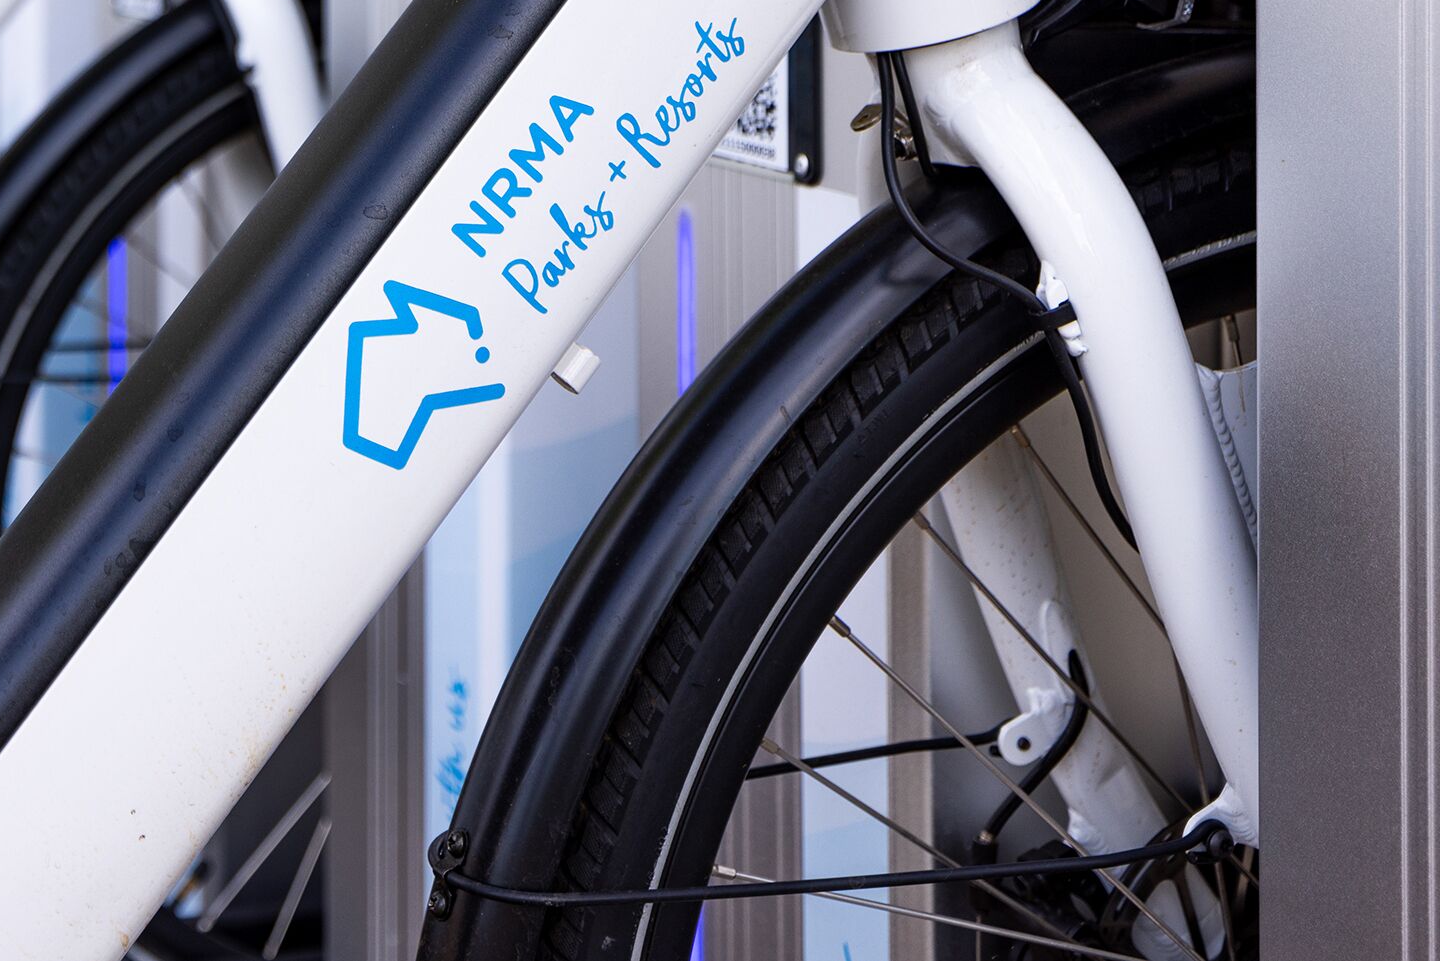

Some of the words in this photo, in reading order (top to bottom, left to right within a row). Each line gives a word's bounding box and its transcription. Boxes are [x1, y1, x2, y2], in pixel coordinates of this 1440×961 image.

[616, 17, 745, 168] Resorts
[451, 95, 595, 258] NRMA
[608, 160, 627, 182] +
[502, 191, 614, 314] Parks
